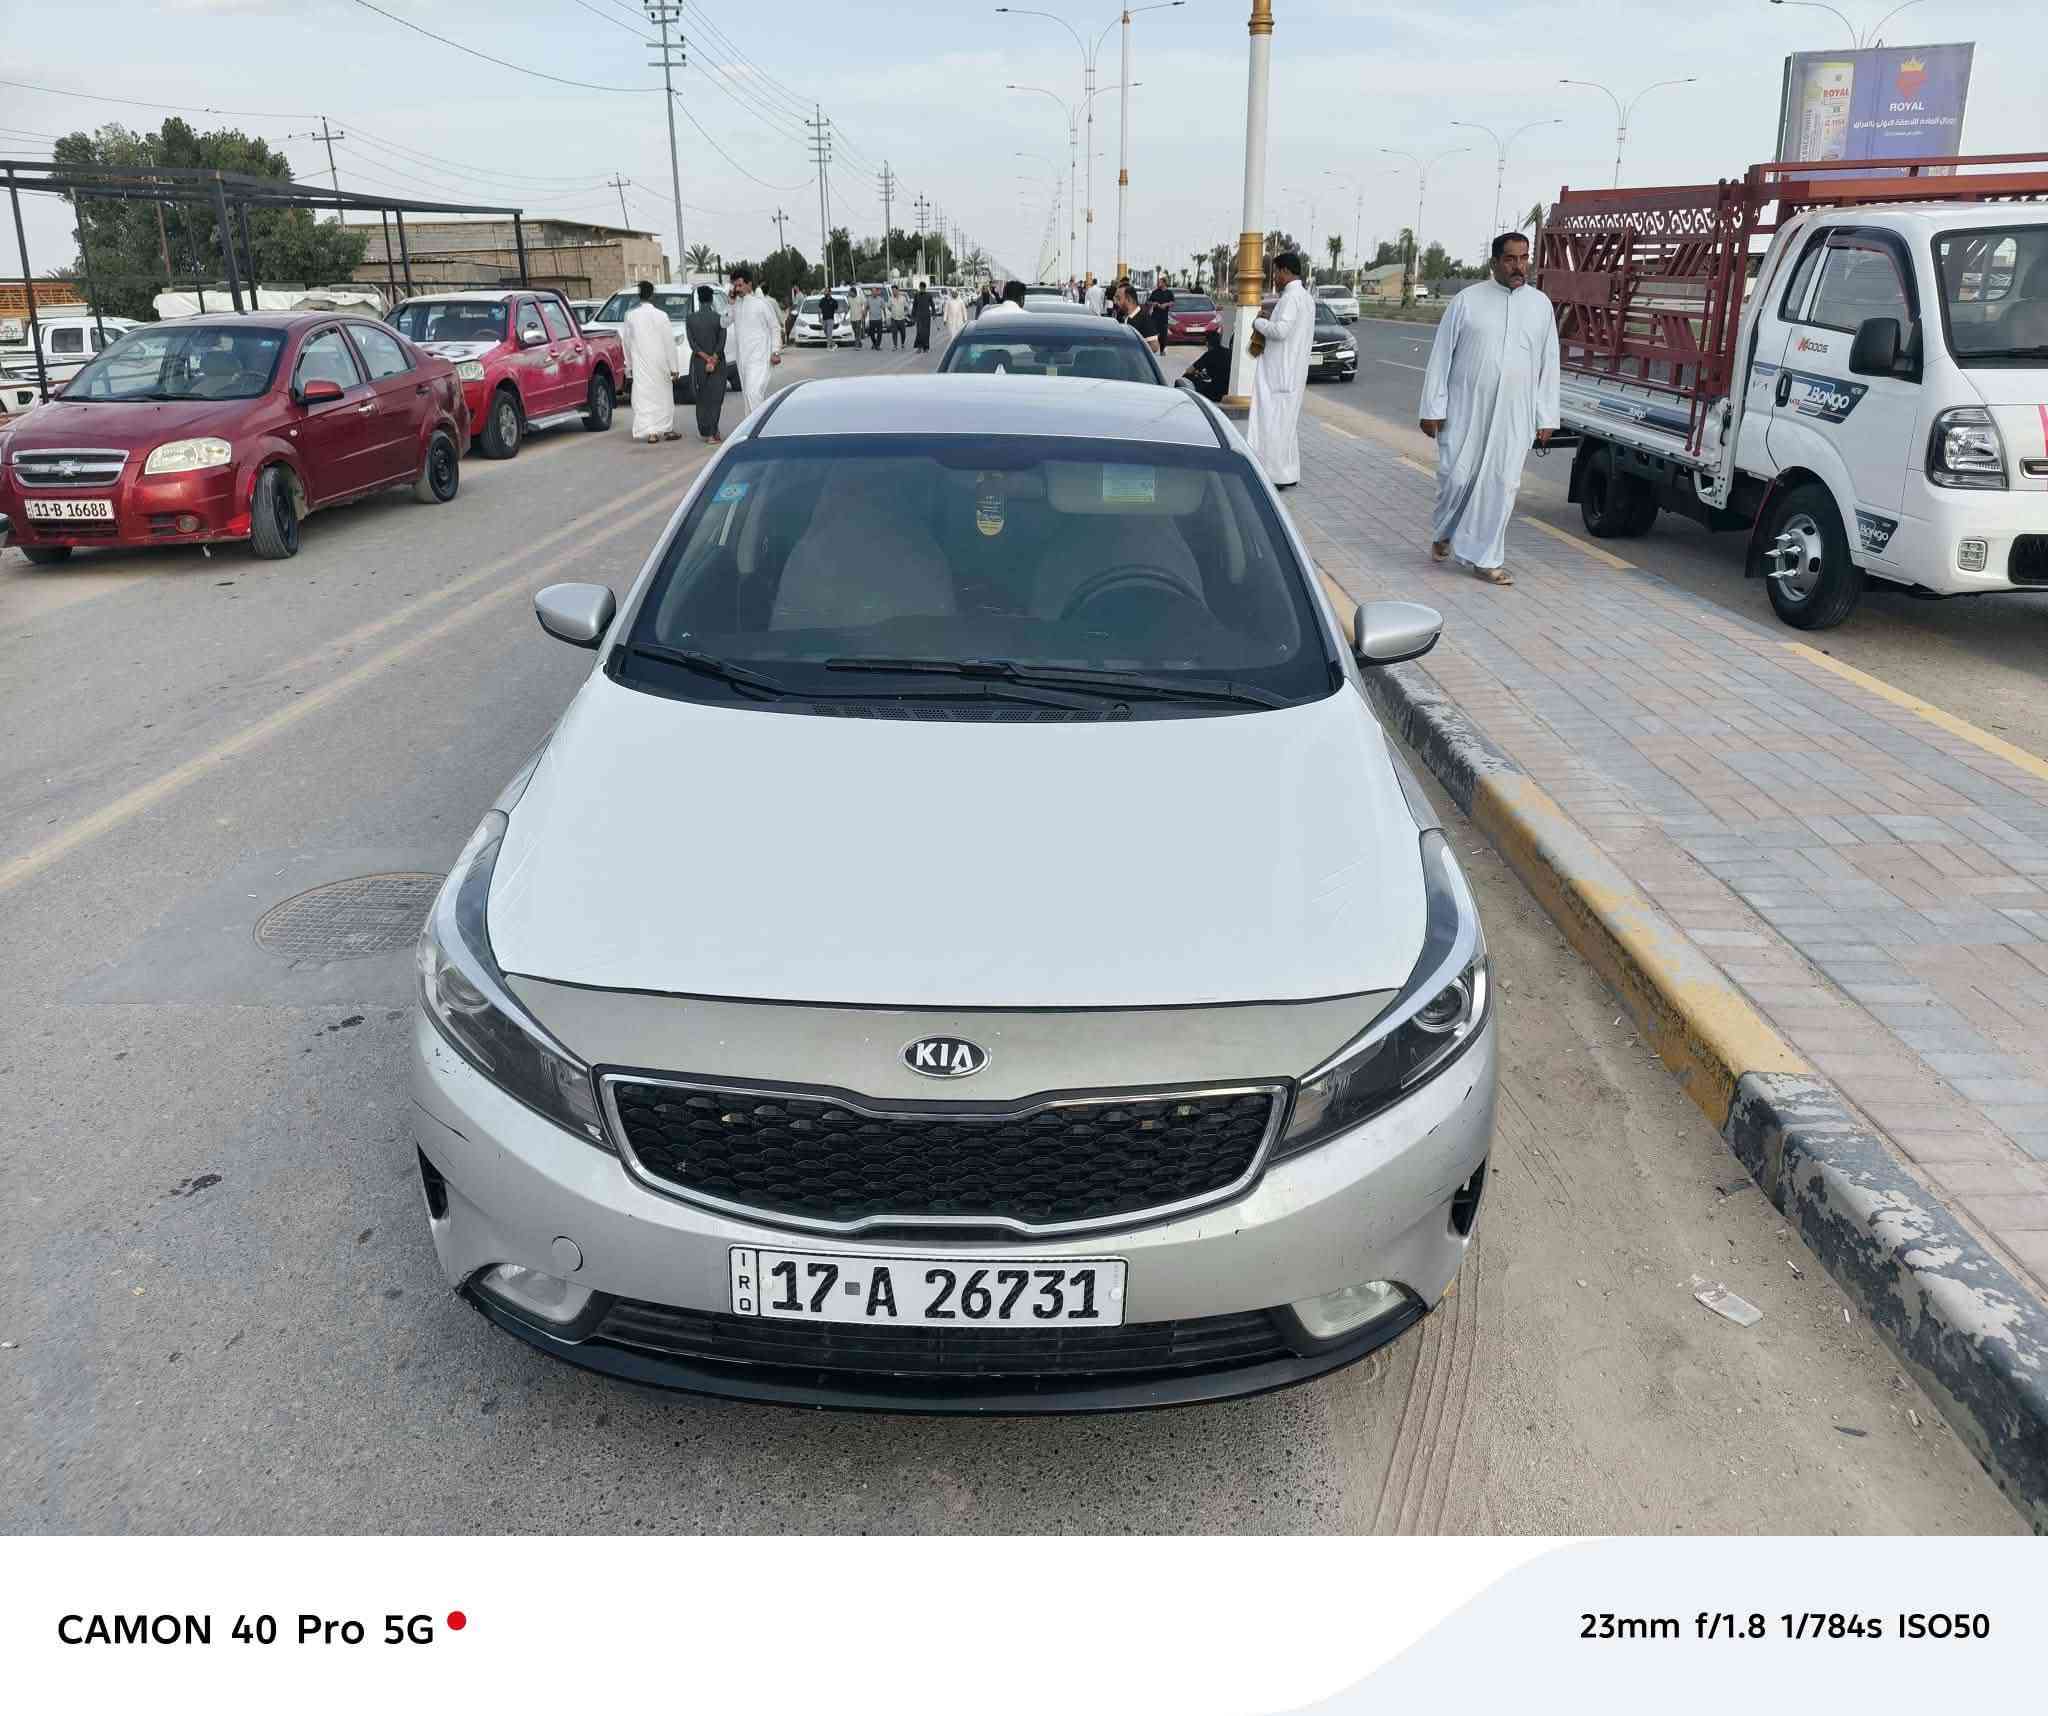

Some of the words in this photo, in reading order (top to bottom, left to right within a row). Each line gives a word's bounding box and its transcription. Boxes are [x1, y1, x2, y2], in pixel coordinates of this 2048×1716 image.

[1889, 102, 1925, 112] ROYAL
[66, 503, 107, 517] 16688
[916, 1043, 974, 1074] KIA
[924, 1268, 1100, 1320] 26731
